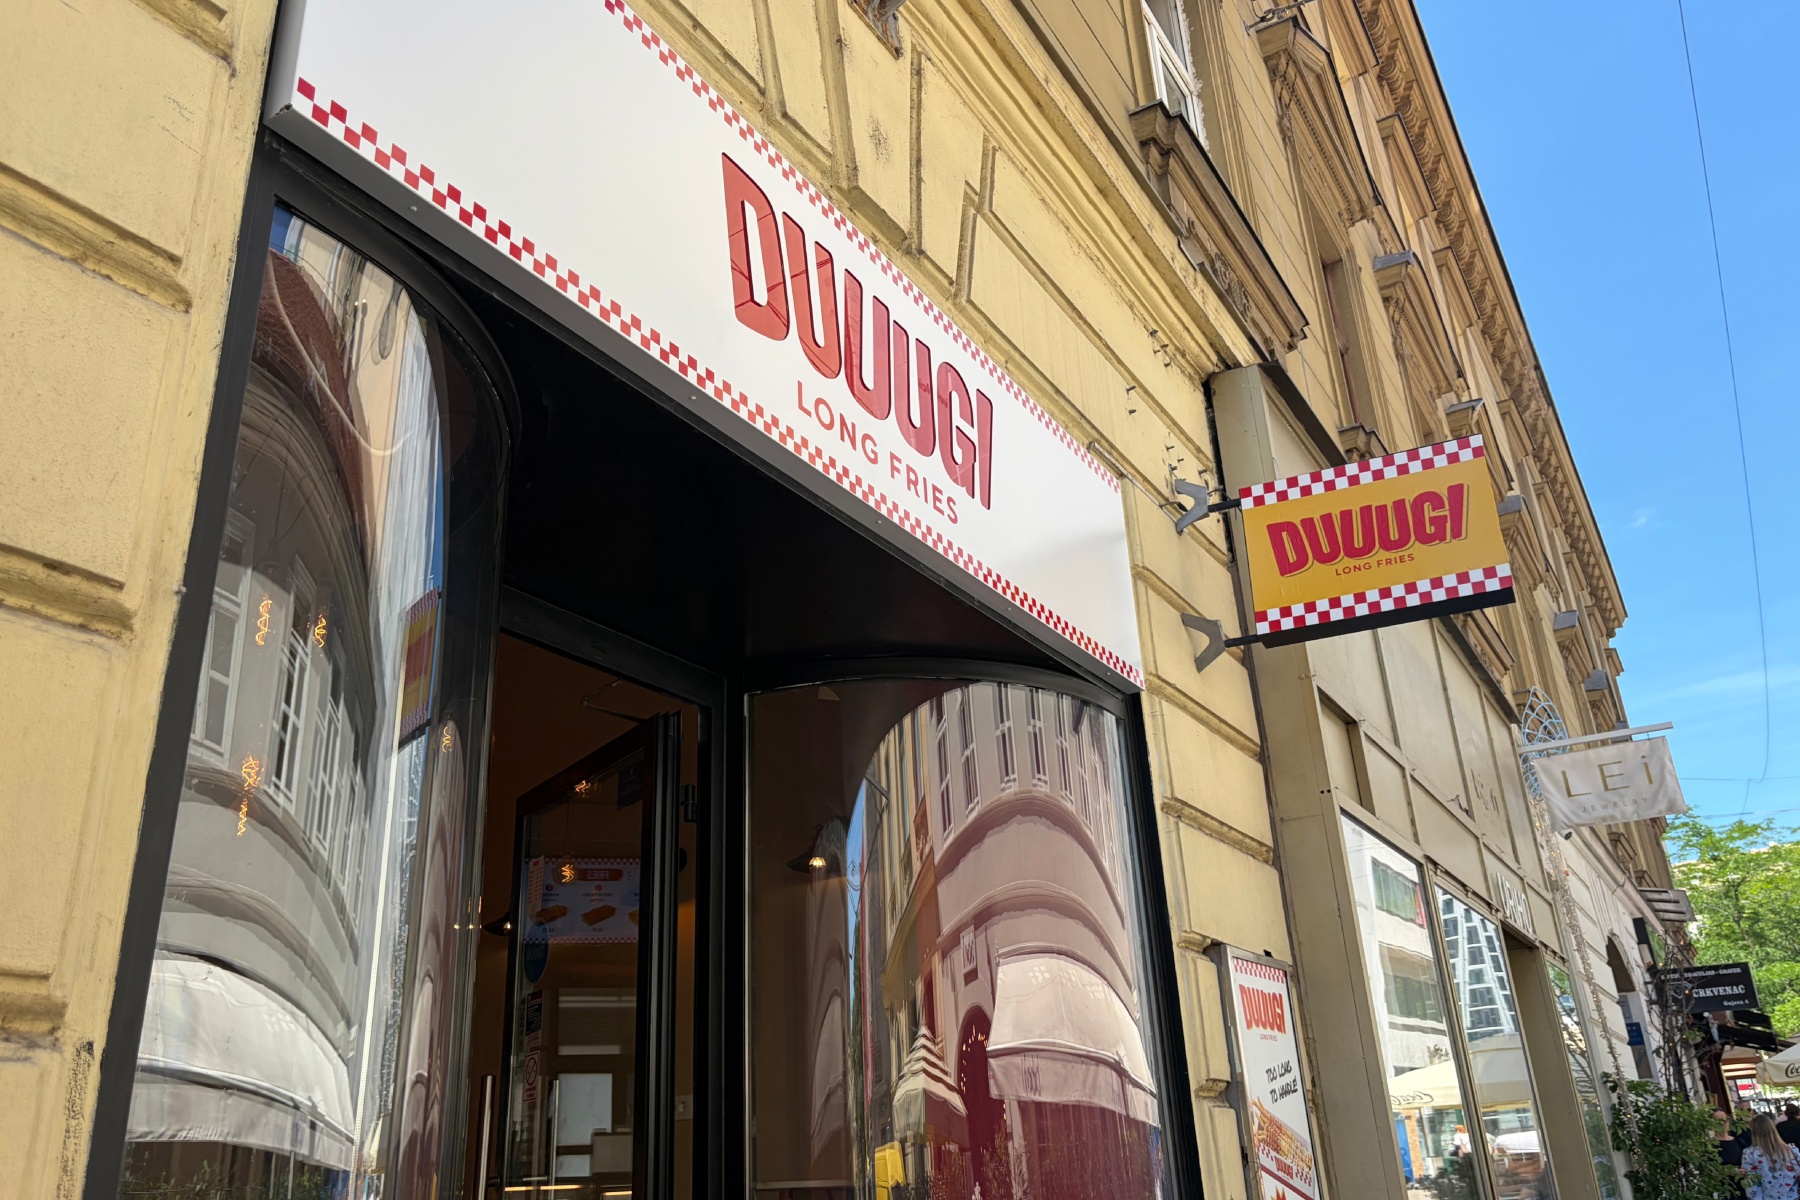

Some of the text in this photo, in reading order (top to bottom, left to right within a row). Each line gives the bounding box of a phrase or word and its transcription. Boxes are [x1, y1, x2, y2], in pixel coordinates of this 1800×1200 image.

[722, 152, 993, 510] DUUUGI
[797, 379, 959, 525] LONG FRIES
[1266, 483, 1467, 577] DUUUGI
[1335, 553, 1415, 577] LONG FRIES
[1581, 797, 1648, 813] JEWELRY
[1692, 985, 1746, 998] CRKVENAC
[1239, 983, 1287, 1035] DUUUGI
[1265, 1059, 1292, 1084] TOO LONG
[1269, 1087, 1278, 1105] TO
